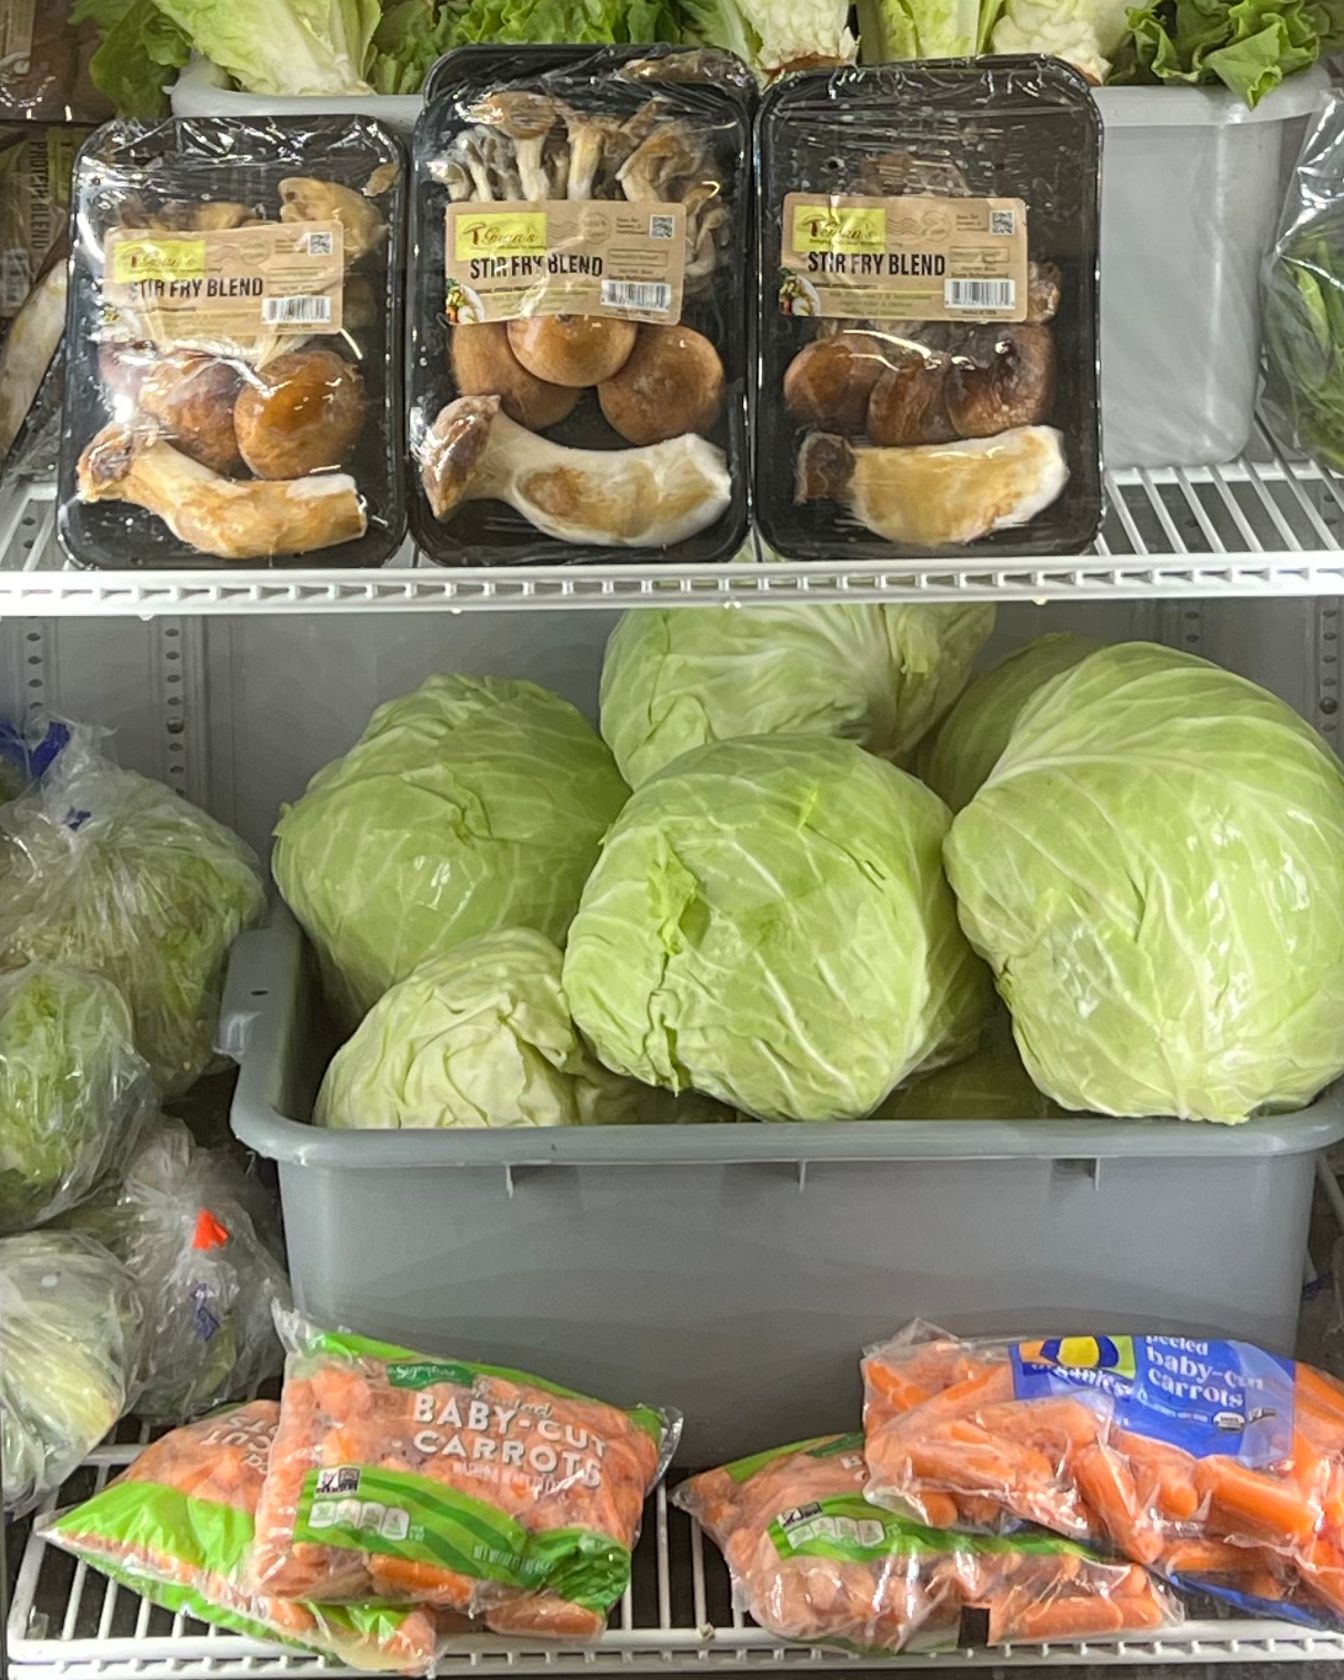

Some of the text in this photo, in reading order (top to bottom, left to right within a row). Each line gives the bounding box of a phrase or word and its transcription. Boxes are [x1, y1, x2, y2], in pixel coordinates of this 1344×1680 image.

[470, 254, 604, 280] STIR FRY BLEND
[808, 250, 945, 277] STIR FRY BLEND
[169, 278, 203, 298] FRY
[206, 277, 264, 297] BLEND
[1146, 1369, 1244, 1408] carrots
[413, 1391, 606, 1458] BABY-CUT
[413, 1429, 602, 1488] CARROTS
